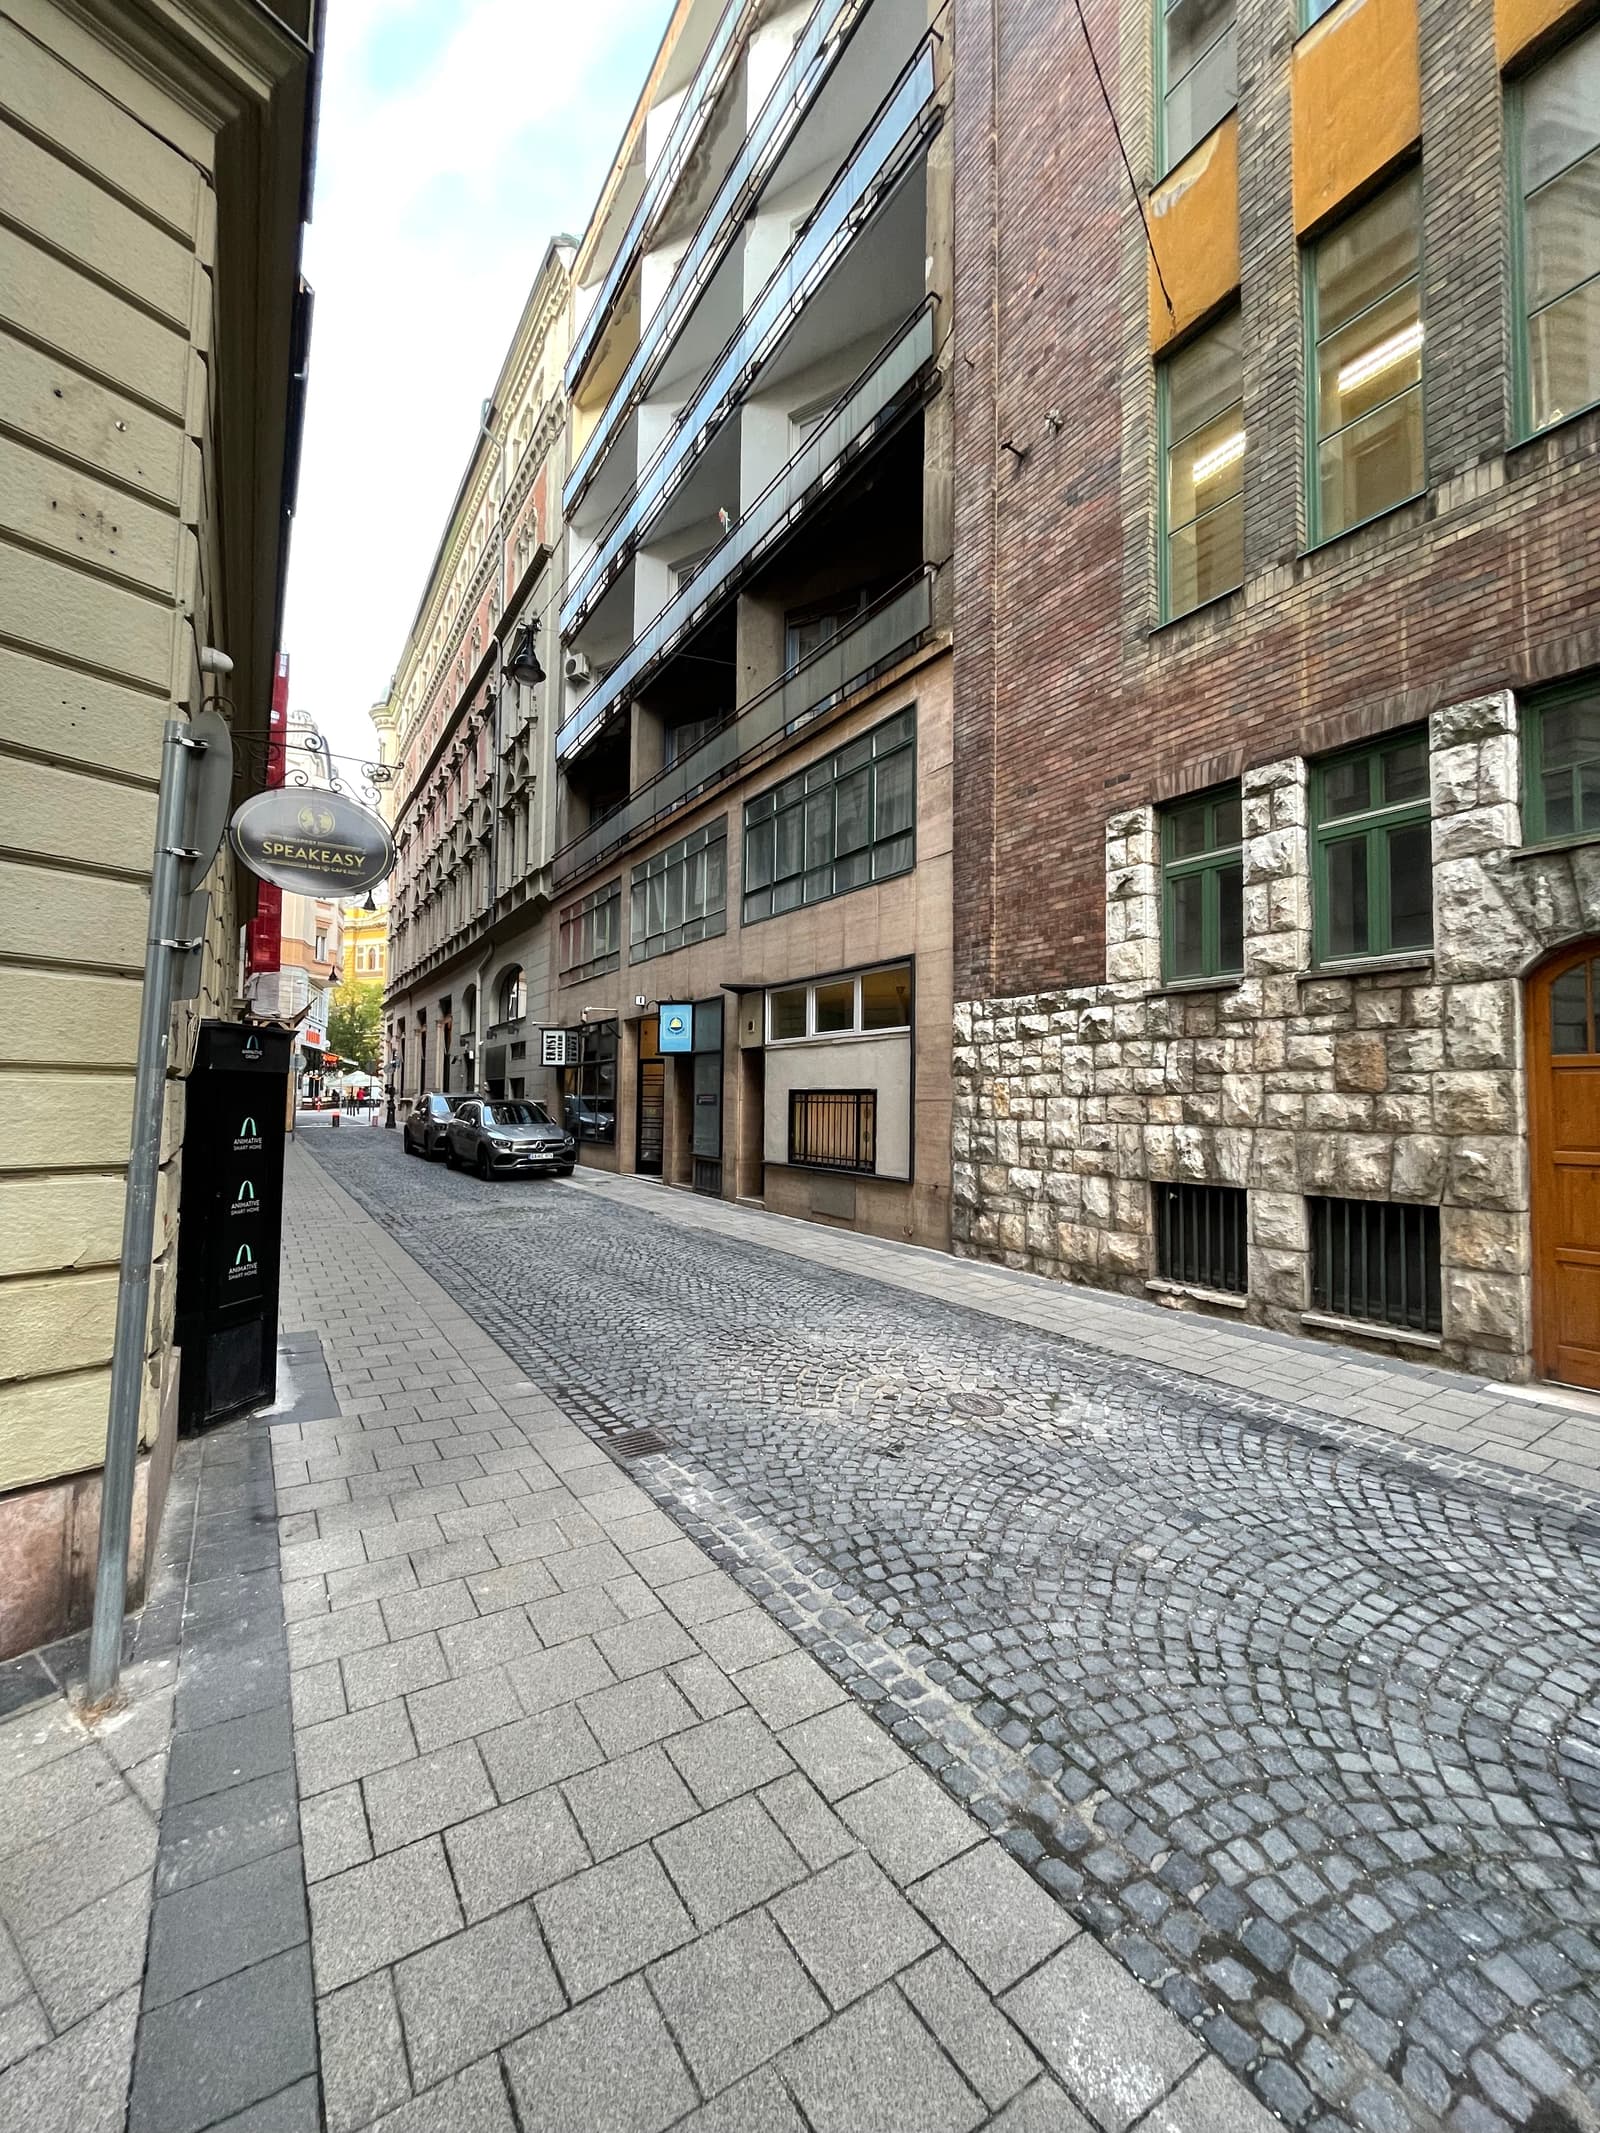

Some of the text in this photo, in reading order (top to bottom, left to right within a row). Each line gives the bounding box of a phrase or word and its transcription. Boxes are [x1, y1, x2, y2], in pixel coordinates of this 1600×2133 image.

[262, 841, 366, 868] SPEAKEASY
[545, 1034, 556, 1061] ERNST
[233, 1137, 262, 1145] ANIMATIVE
[231, 1200, 260, 1209] ANIMATIVE
[229, 1262, 257, 1273] ANIMATIVE
